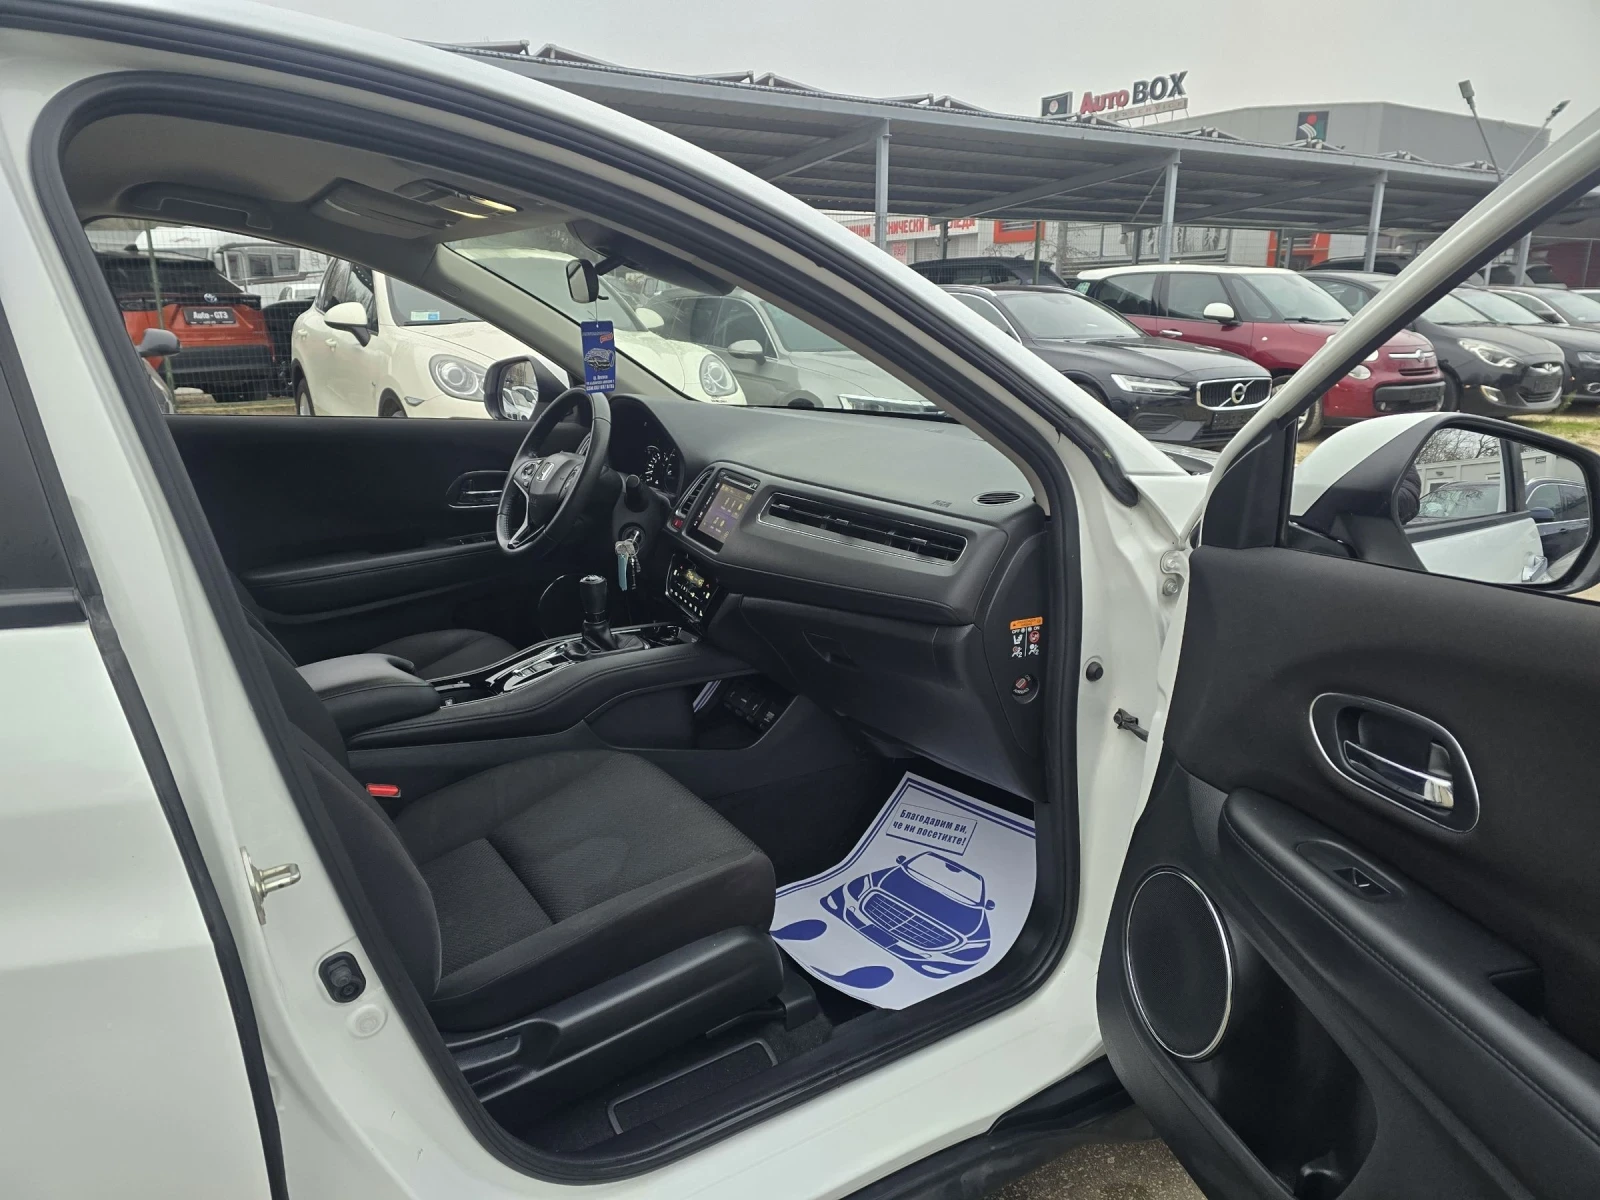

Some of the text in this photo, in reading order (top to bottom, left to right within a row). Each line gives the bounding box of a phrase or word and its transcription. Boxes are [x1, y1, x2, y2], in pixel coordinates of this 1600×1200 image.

[1132, 71, 1188, 104] BOX
[886, 217, 925, 235] НИЧЕСКИ
[900, 809, 953, 830] Благодарим
[892, 821, 967, 846] че ни посетихте!
